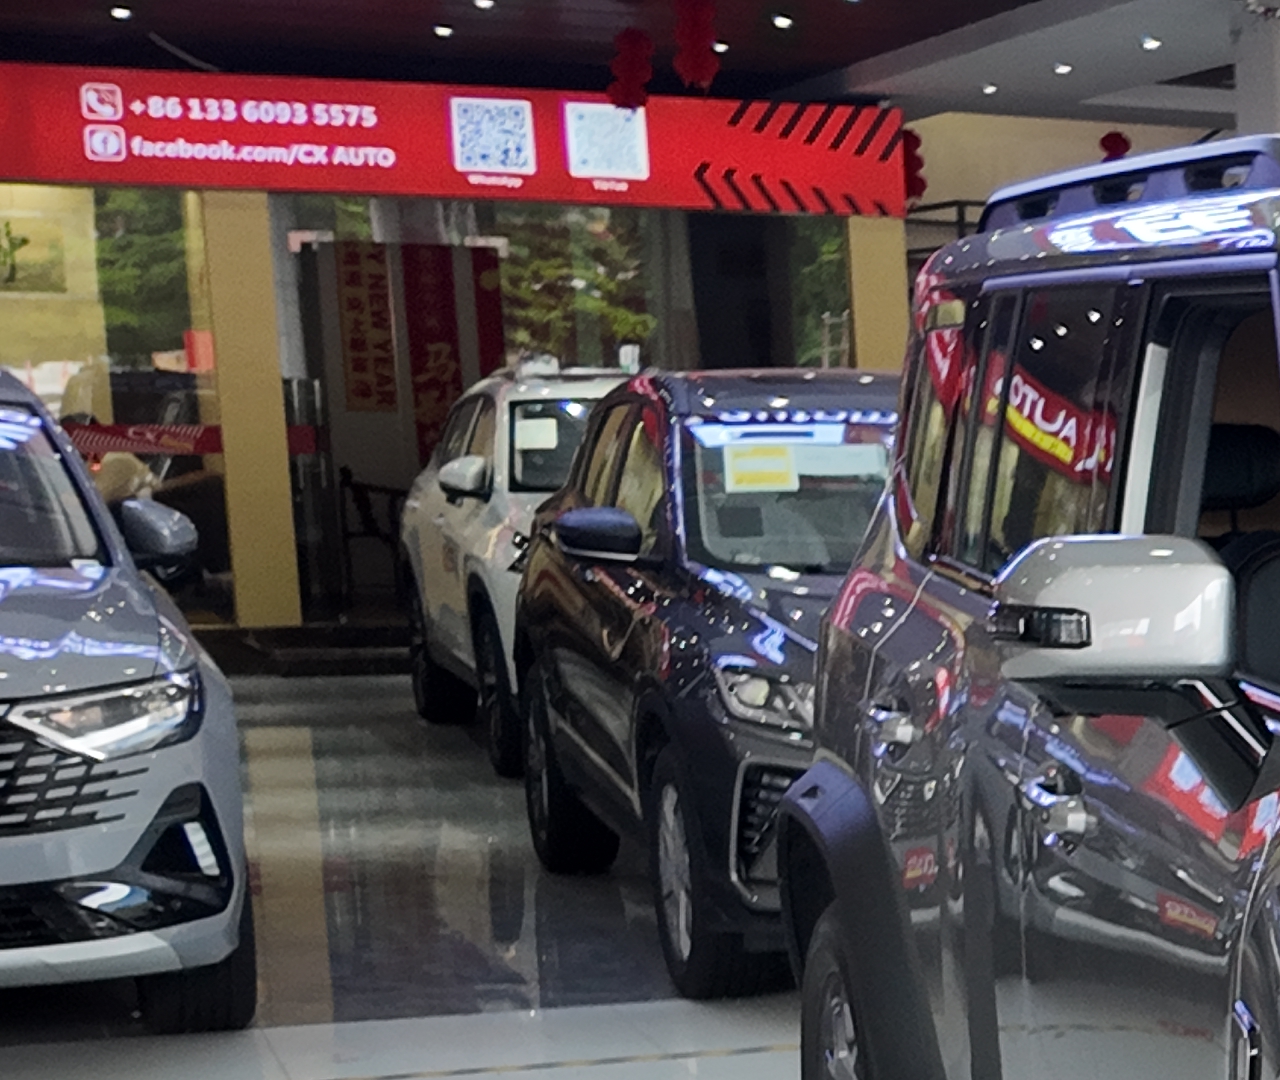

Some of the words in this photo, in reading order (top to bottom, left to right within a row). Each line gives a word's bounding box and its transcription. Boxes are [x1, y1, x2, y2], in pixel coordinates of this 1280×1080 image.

[129, 96, 183, 120] +86
[187, 98, 237, 122] 133
[242, 101, 308, 125] 6093
[312, 104, 378, 128] 5575
[130, 135, 329, 166] facebook.com/CX
[332, 146, 397, 168] AUTO
